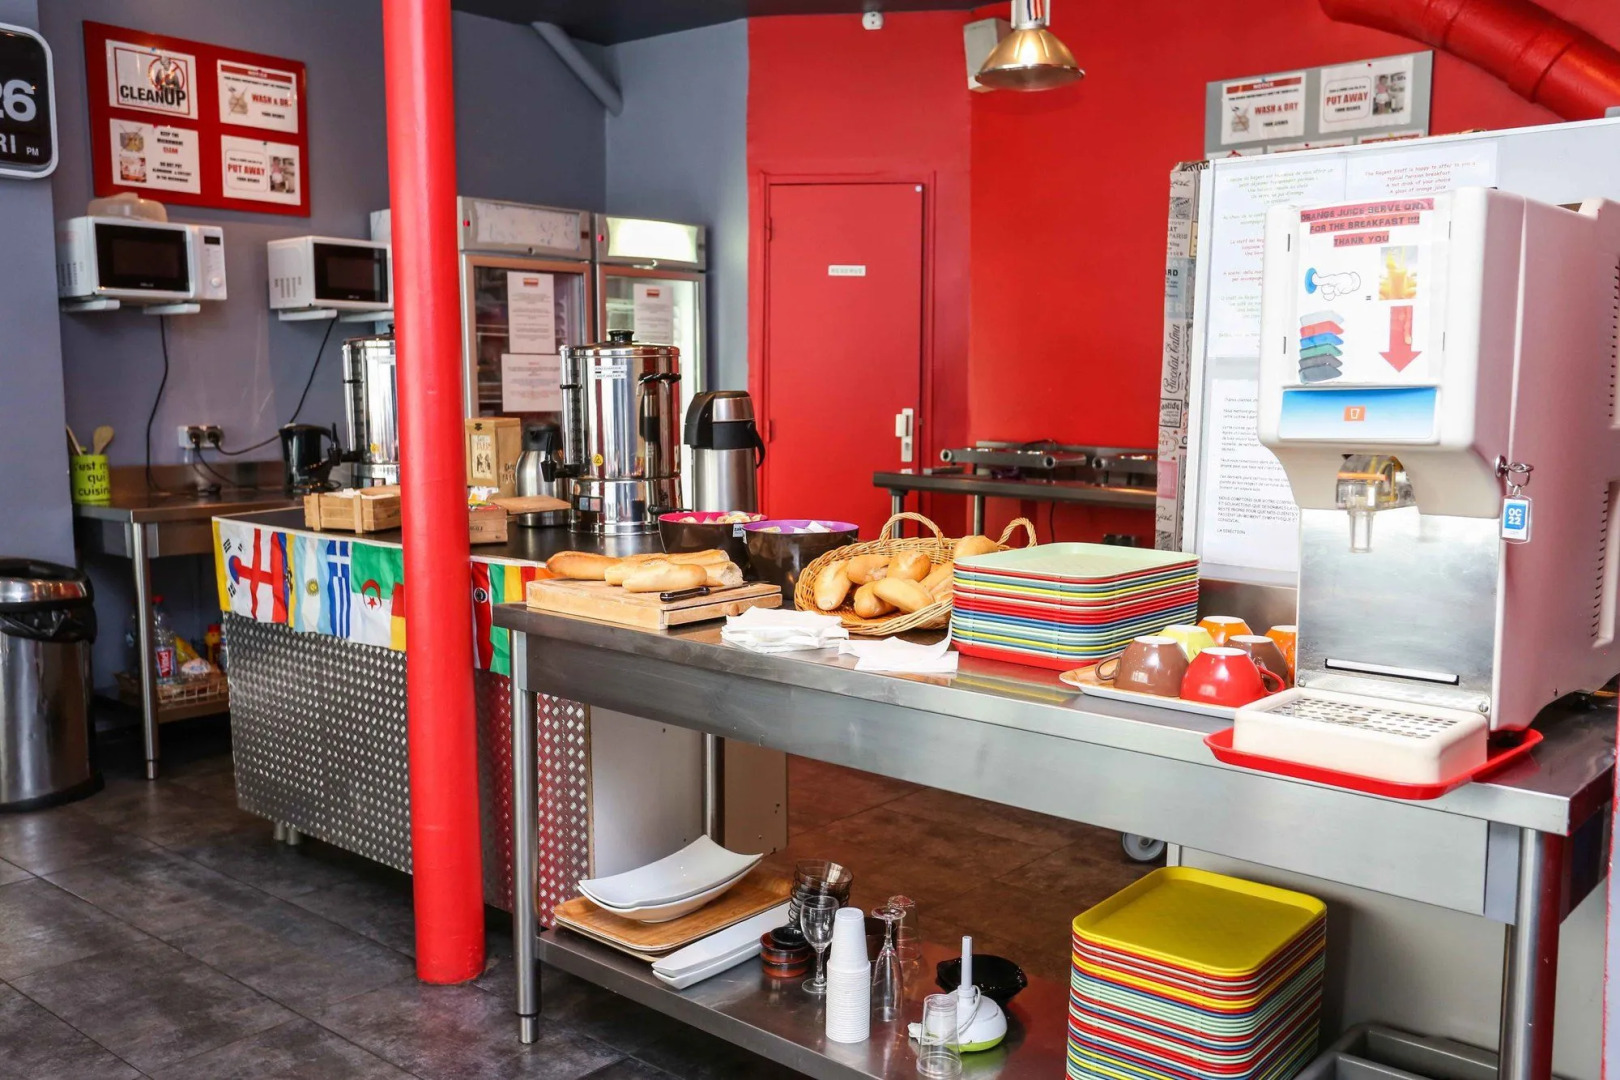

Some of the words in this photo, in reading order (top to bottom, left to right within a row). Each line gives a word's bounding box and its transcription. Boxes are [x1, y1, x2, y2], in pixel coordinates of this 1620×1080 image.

[0, 79, 36, 122] 6
[1326, 95, 1341, 106] PUT
[1343, 92, 1368, 103] AWAY
[1255, 104, 1276, 115] WASH
[1284, 102, 1298, 111] DRY
[26, 146, 39, 156] PM
[1301, 210, 1334, 221] ORANGE
[1337, 208, 1364, 217] JUICE
[1368, 205, 1400, 214] SERVE
[1310, 224, 1326, 233] FOR
[1329, 222, 1345, 230] THE
[1348, 216, 1404, 229] BREAKFAST
[1334, 238, 1364, 247] THANK
[1369, 235, 1389, 243] YOU
[88, 472, 106, 484] qui
[1508, 507, 1521, 517] OC
[1508, 516, 1521, 526] 22
